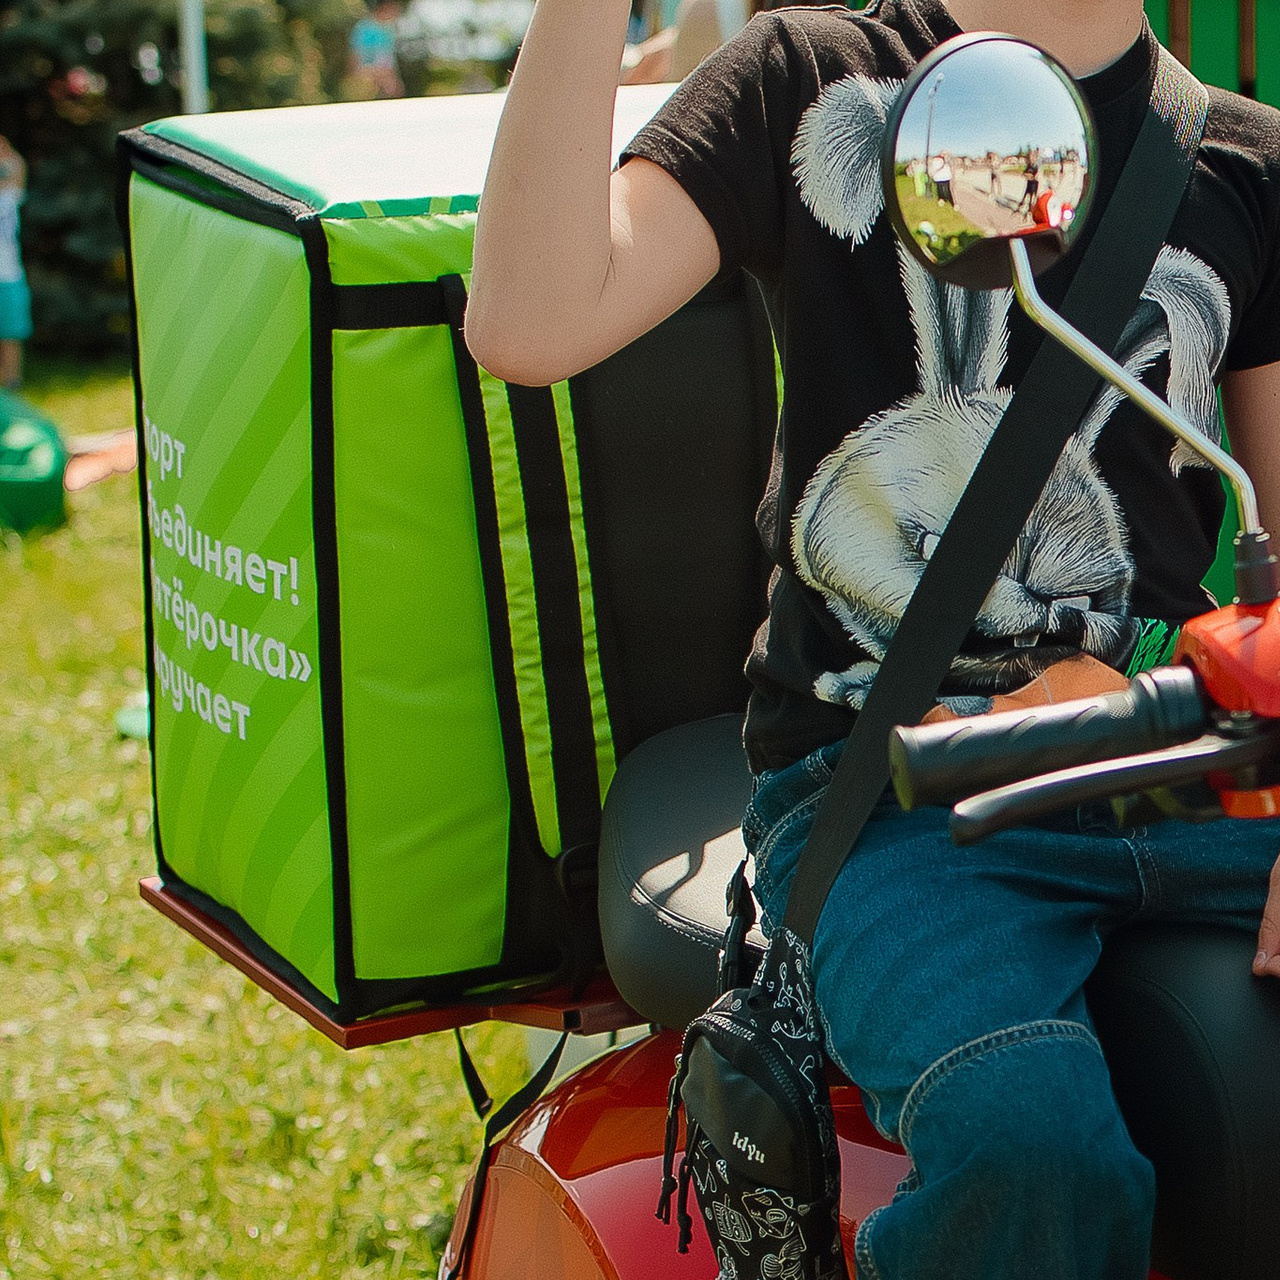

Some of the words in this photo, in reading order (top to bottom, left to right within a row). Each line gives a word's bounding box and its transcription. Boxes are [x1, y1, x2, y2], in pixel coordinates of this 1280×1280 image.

[143, 411, 187, 481] орт
[147, 490, 299, 606] ъединяет!
[152, 558, 313, 682] ятёрочка»
[154, 644, 251, 741] ручает
